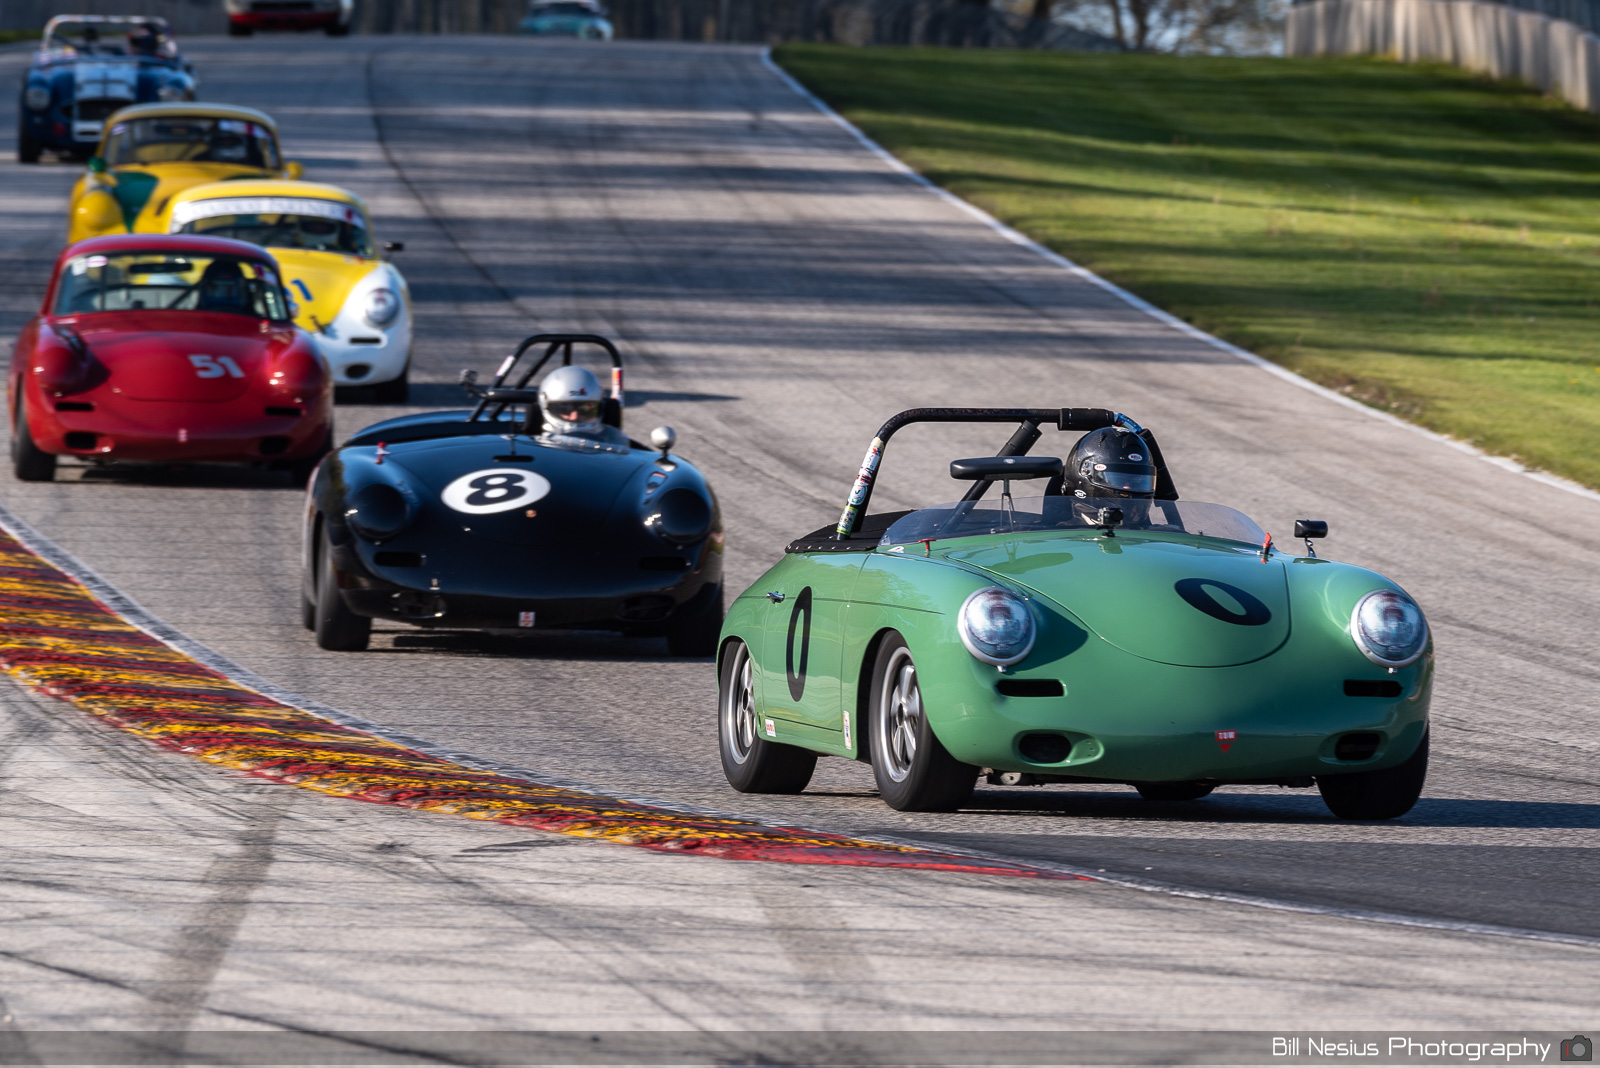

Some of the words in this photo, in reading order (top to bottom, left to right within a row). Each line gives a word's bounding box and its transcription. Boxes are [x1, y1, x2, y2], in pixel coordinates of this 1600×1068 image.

[189, 355, 245, 378] 51
[465, 473, 528, 507] 8
[1174, 578, 1271, 626] 0
[785, 586, 812, 702] 0
